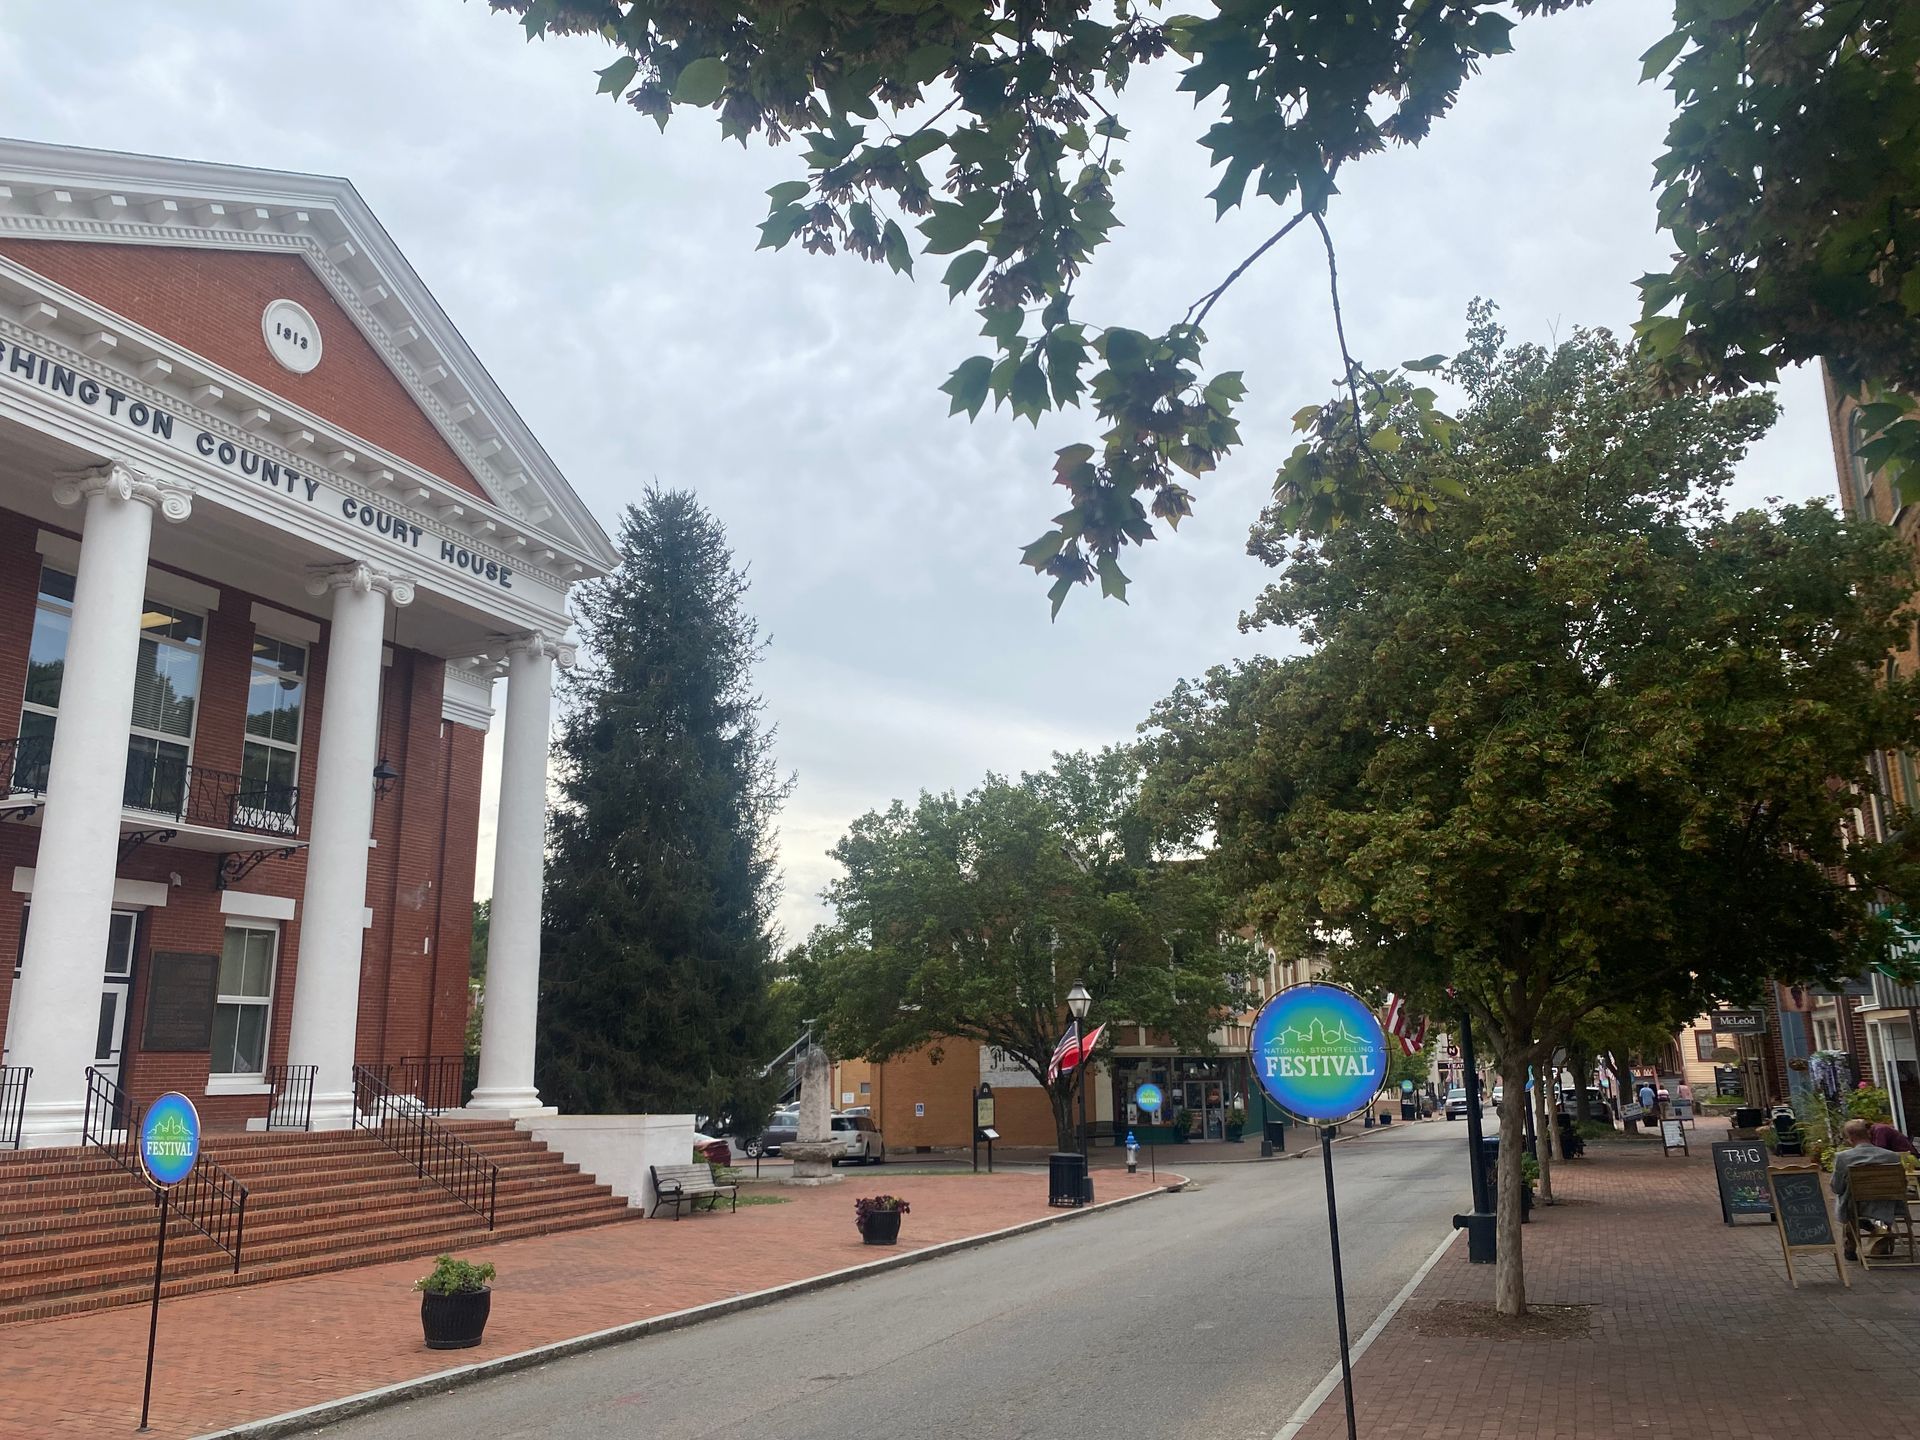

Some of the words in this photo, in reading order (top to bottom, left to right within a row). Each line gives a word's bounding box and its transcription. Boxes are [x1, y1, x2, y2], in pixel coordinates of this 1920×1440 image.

[276, 322, 308, 350] 1913
[0, 340, 173, 439] HINGTON
[196, 432, 320, 501] COUNTY
[342, 498, 423, 547] COURT
[441, 540, 513, 589] HOUSE
[1719, 1016, 1756, 1026] McLeod
[1263, 1047, 1306, 1055] NATIONAL
[1310, 1045, 1374, 1054] STORYTELLING
[1264, 1055, 1376, 1078] FESTIVAL
[146, 1141, 193, 1156] FESTIVAL
